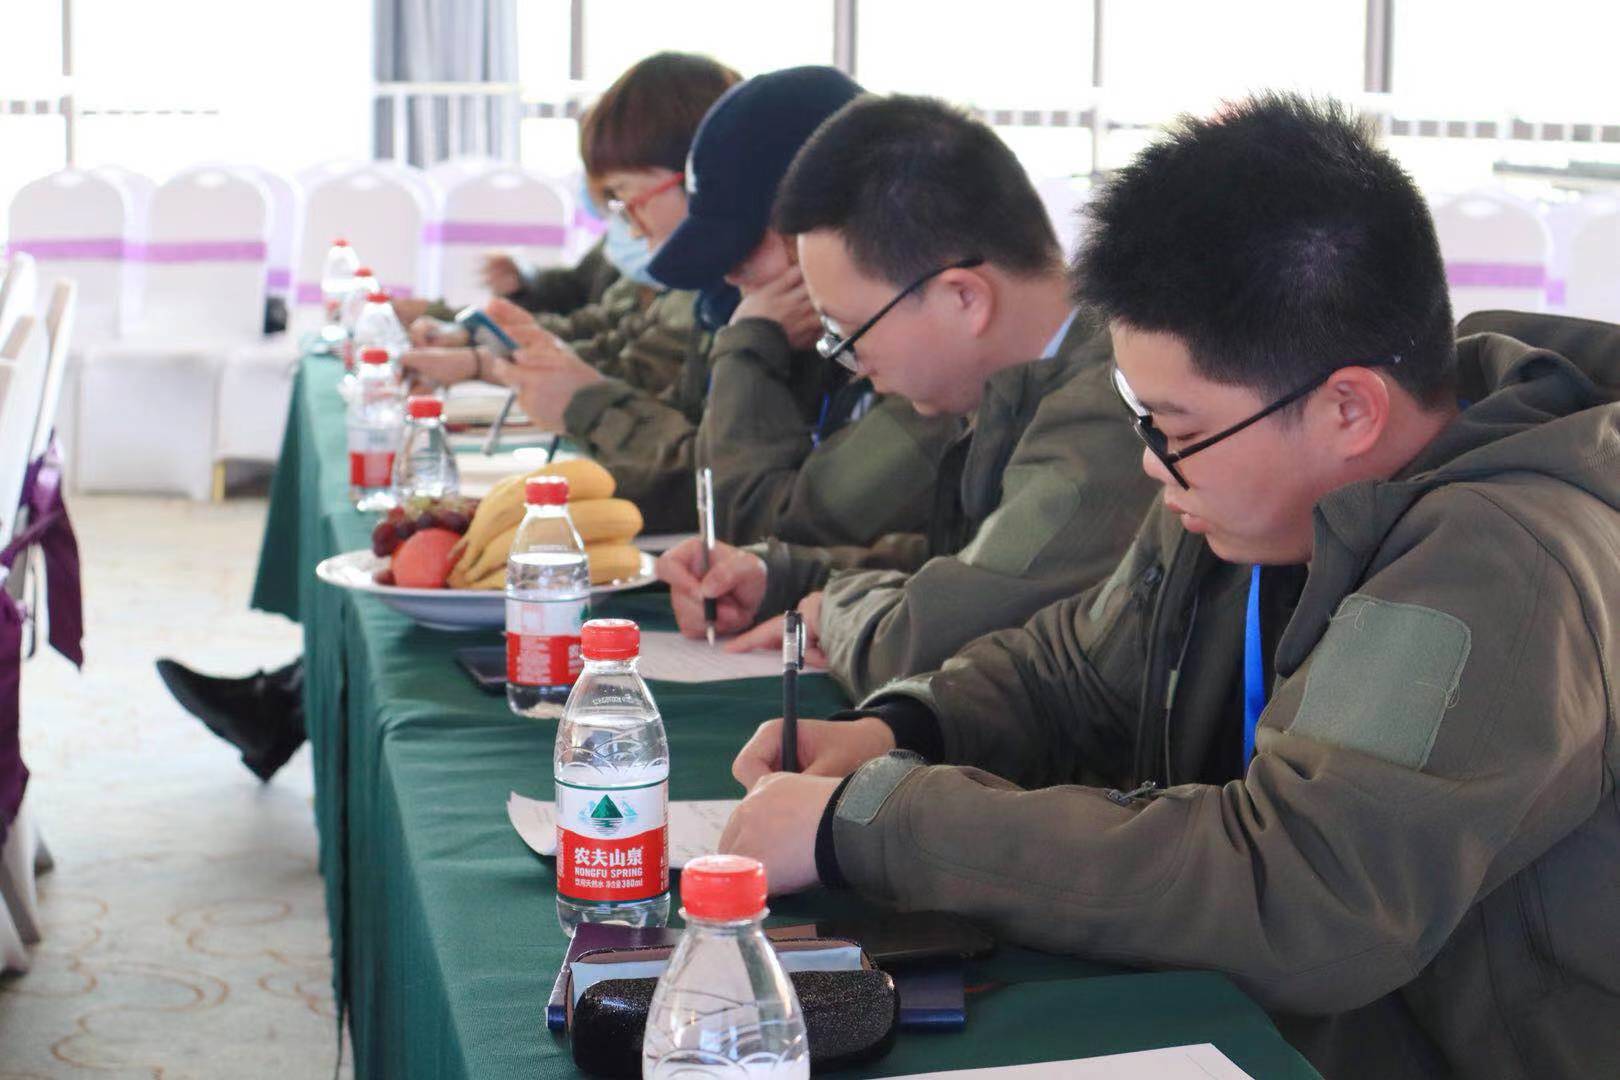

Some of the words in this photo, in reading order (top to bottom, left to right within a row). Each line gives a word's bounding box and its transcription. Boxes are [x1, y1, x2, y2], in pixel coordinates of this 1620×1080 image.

[575, 847, 643, 867] 农夫山泉
[575, 867, 607, 878] NONGFU
[610, 867, 643, 878] SPRING
